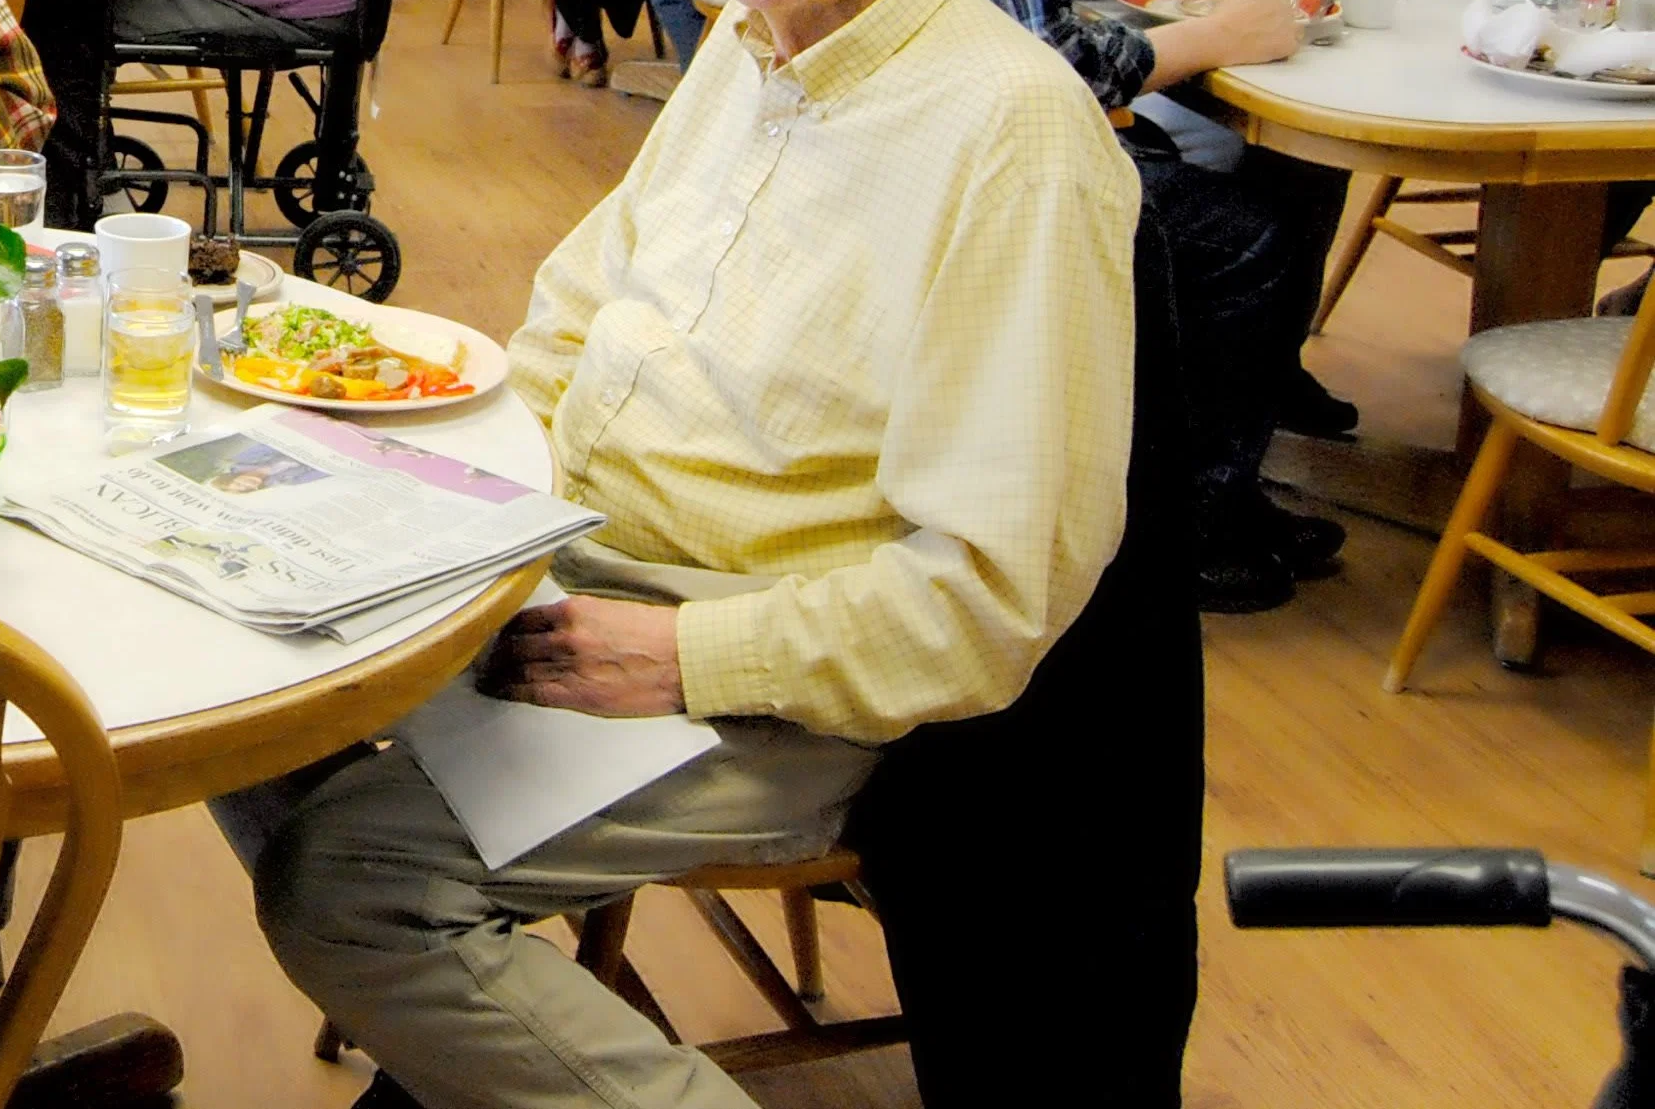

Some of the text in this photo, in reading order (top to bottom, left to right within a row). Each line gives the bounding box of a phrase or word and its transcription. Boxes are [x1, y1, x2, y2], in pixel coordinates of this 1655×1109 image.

[150, 478, 171, 491] to
[168, 489, 210, 512] what
[308, 549, 351, 568] just
